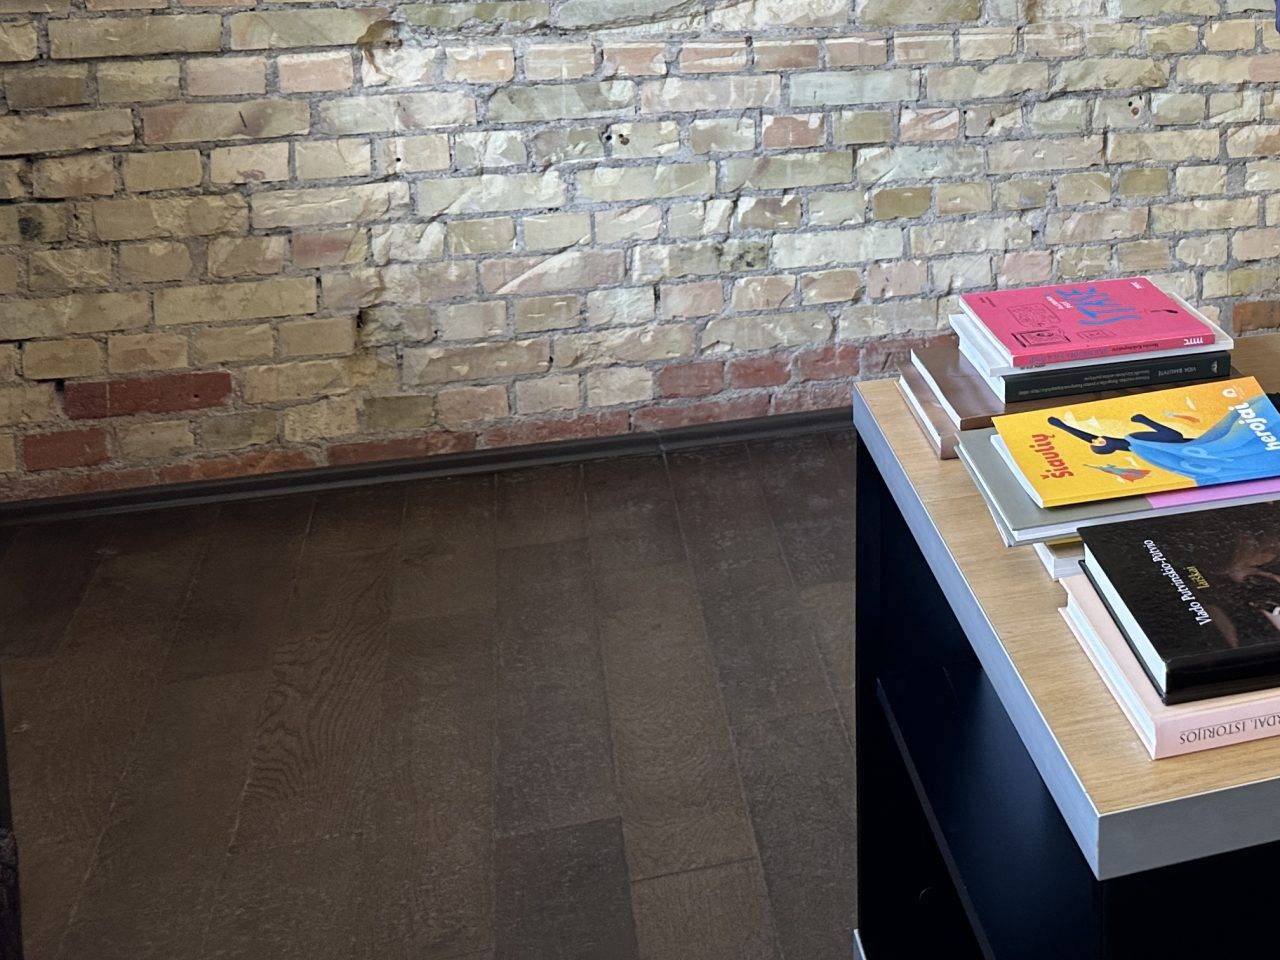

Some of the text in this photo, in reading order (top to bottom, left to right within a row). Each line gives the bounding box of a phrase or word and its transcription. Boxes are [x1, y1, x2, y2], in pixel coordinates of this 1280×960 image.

[1029, 434, 1074, 480] Šiaulių
[1188, 601, 1212, 626] Vlado
[1179, 722, 1246, 745] ISTORIJOS
